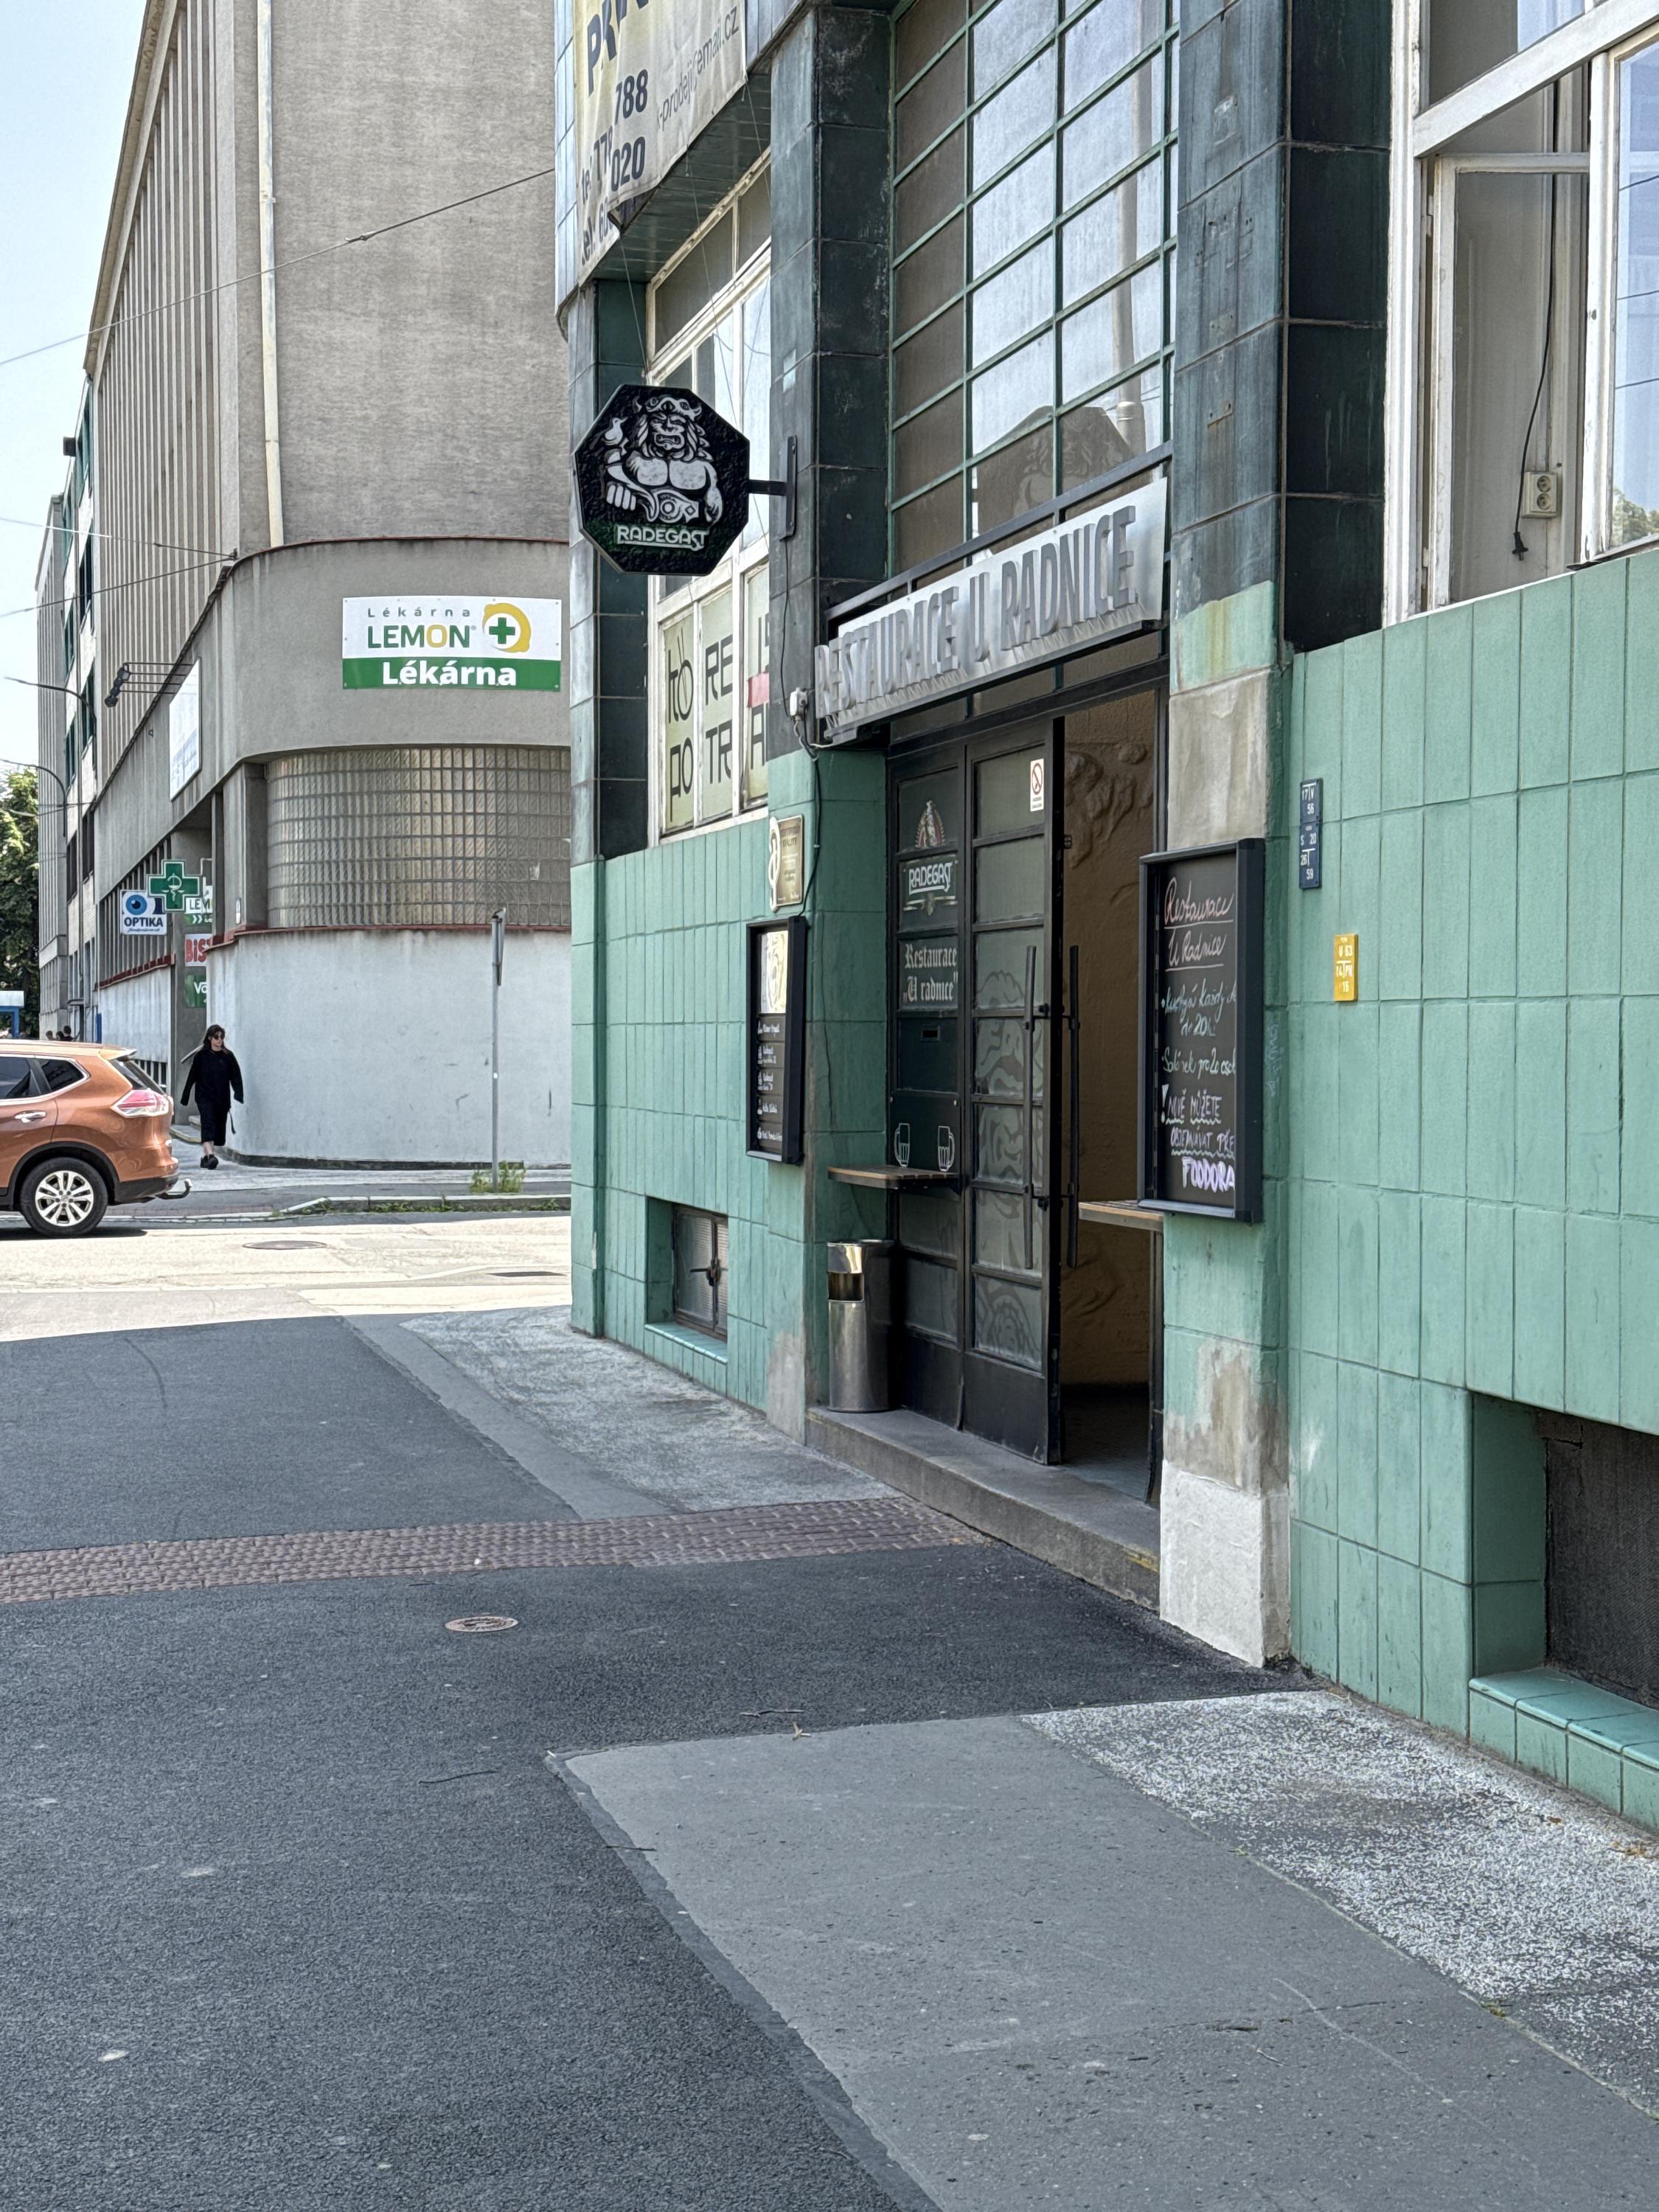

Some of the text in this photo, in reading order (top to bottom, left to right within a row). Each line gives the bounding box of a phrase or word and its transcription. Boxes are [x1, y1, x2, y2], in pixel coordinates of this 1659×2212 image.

[611, 136, 646, 192] 020
[616, 524, 709, 552] RADEGAST
[367, 606, 470, 618] Lékárna
[814, 505, 1136, 720] RESTAURACE U RADNICE
[367, 625, 470, 649] LEMON
[383, 660, 517, 686] Lékárna
[909, 860, 953, 895] RADEGAST
[124, 917, 164, 928] OPTIKA
[904, 943, 957, 969] Restaurace
[1181, 1155, 1237, 1194] FOODORA
